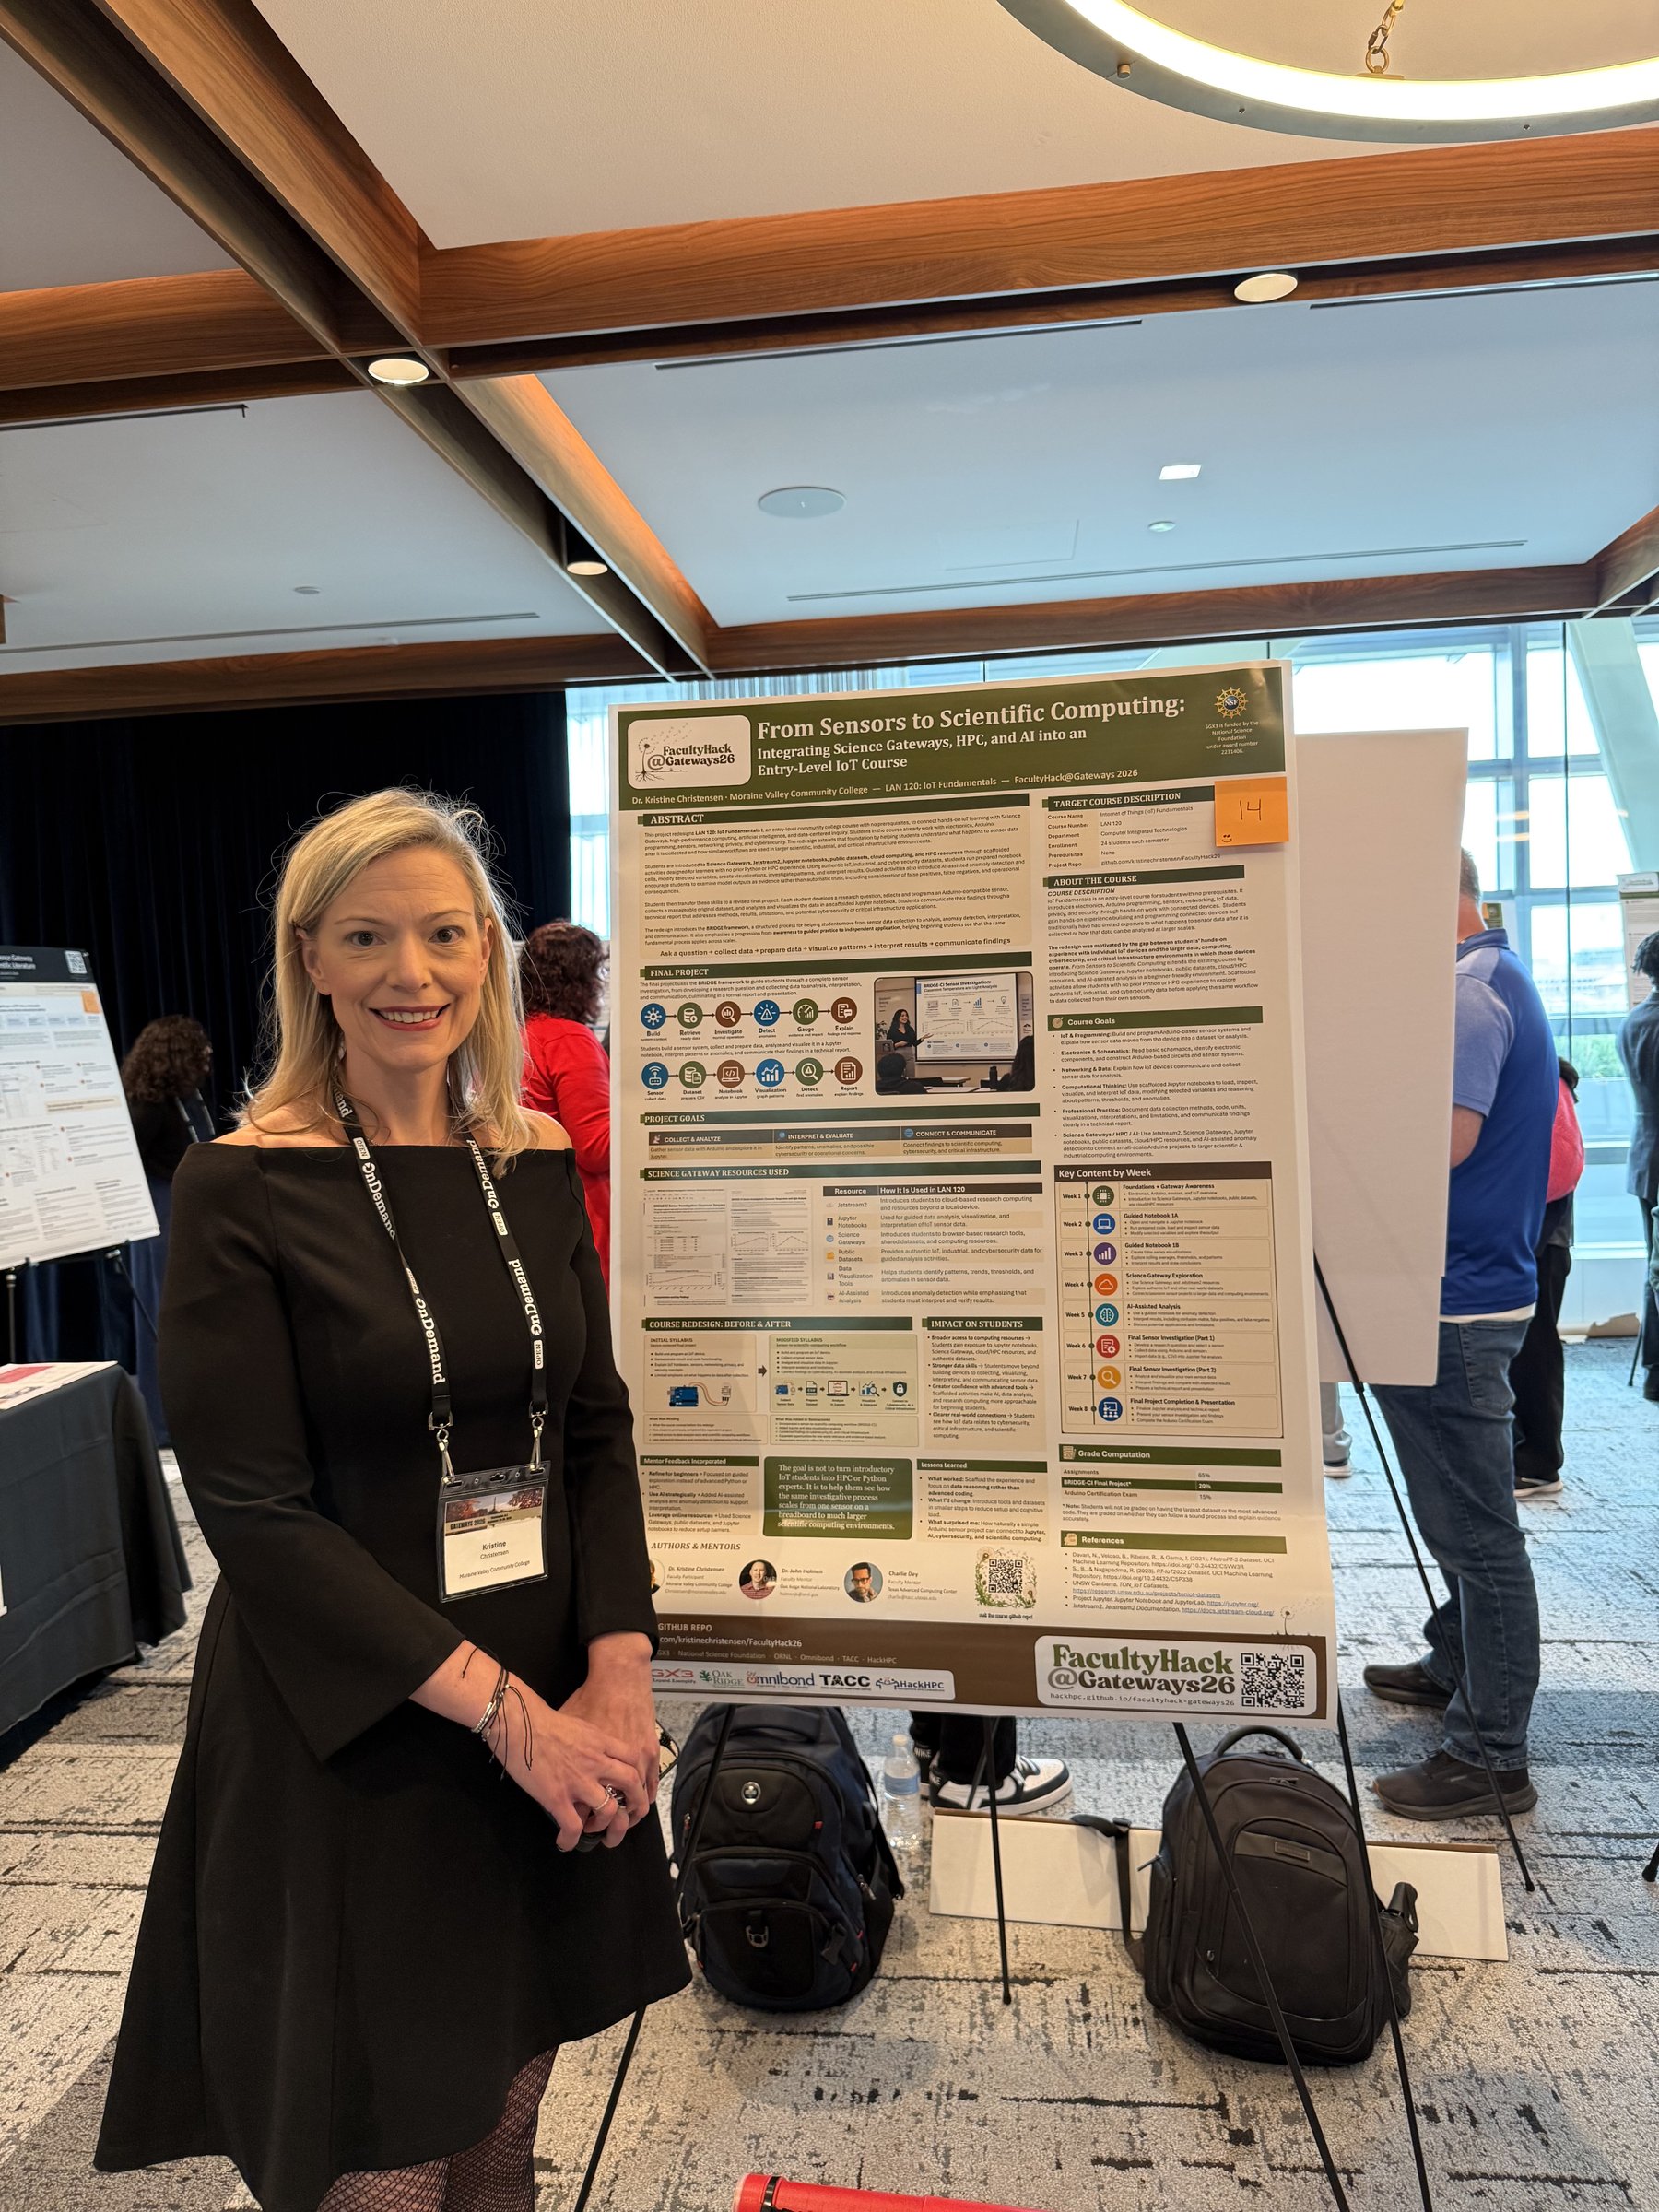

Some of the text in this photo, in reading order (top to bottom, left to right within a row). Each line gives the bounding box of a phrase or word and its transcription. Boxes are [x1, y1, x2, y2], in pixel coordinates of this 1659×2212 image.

[758, 696, 1184, 739] From Sensors to Scientific Computing:
[663, 743, 732, 758] FacultyHack
[758, 729, 1086, 760] Integrating Science Gateways, HPC, and AI into an
[647, 752, 735, 770] @Gateways26
[758, 758, 907, 777] Entry-Level IoT Course
[645, 795, 675, 804] Kristine
[729, 792, 762, 800] Moraine
[764, 790, 789, 799] Valley
[790, 787, 837, 797] Community
[838, 786, 867, 794] College
[885, 783, 901, 792] LAN
[903, 782, 921, 790] 120:
[924, 781, 936, 789] IoT
[938, 777, 996, 788] Fundamentals
[1014, 771, 1114, 783] FacultyHack@Gateways
[1116, 769, 1137, 777] 2026
[1053, 792, 1180, 807] TARGET COURSE DESCRIPTION
[1239, 798, 1262, 821] 14
[650, 814, 703, 824] ABSTRACT
[1053, 877, 1083, 886] ABOUT
[1103, 875, 1136, 883] COURSE
[675, 968, 708, 976] PROJECT
[796, 1026, 814, 1034] Gauge
[356, 1139, 368, 1158] OPEN
[681, 1169, 720, 1177] GATEWAY
[722, 1168, 767, 1176] RESOURCES
[1059, 1168, 1151, 1179] Key Content by Week
[495, 1214, 506, 1233] OPEN
[508, 1259, 543, 1336] OnDemand
[415, 1297, 446, 1385] OnDemand
[1101, 1450, 1150, 1458] Computation
[792, 1465, 806, 1475] goal
[852, 1465, 894, 1476] introductory
[482, 1540, 507, 1551] Kristine
[1081, 1535, 1124, 1544] References
[480, 1549, 510, 1559] Christensen
[459, 1571, 477, 1579] Moraine
[490, 1563, 514, 1573] Community
[514, 1559, 530, 1569] College
[657, 1622, 712, 1631] GITHUB REPO
[660, 1636, 802, 1647] com/kristinechristensen/FacultyHack26
[1053, 1644, 1233, 1676] FacultyHack
[651, 1668, 694, 1678] GX3
[712, 1670, 733, 1678] OAK
[712, 1677, 743, 1686] RIDGE
[819, 1674, 871, 1688] TACC
[900, 1680, 944, 1689] HackHPC
[1047, 1667, 1235, 1695] @Gateways26
[1050, 1693, 1234, 1706] hackhpc.github.io/facultyhack-gateways26
